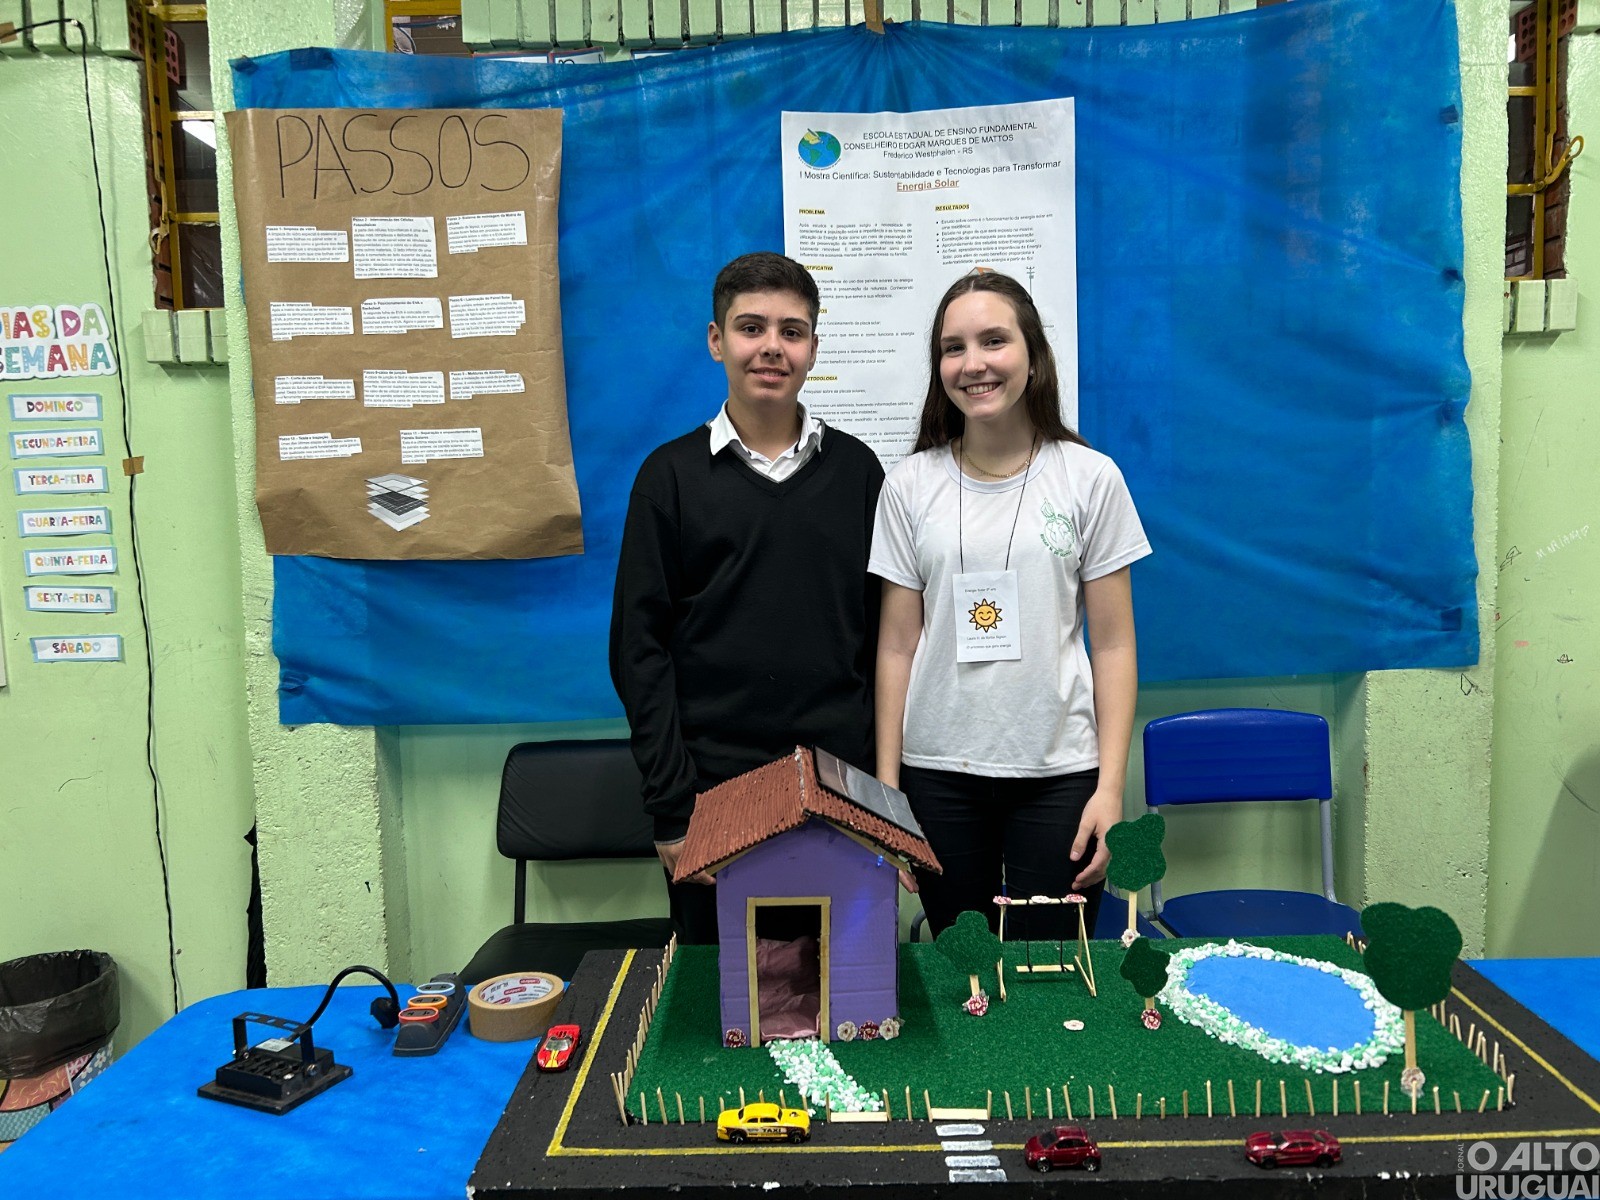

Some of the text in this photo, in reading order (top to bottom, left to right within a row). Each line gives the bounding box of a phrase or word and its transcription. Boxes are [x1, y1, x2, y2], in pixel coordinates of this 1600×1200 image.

[863, 122, 1037, 140] ESCOLA ESTADUAL DE ENSINO FUNDAMENTAL
[844, 134, 1014, 151] CONSELHEIRO EDGAR MARQUES DE MATTOS
[276, 113, 530, 199] PASSOS
[883, 150, 913, 159] Frederico
[915, 149, 956, 159] Westphalen
[804, 172, 830, 180] Mostra
[873, 170, 934, 179] Sustentabilidade
[944, 166, 990, 176] Tecnologias
[992, 165, 1011, 174] para
[1013, 159, 1061, 171] Transformar
[896, 179, 959, 192] Energia Solar
[0, 308, 103, 340] IAS DA
[27, 401, 83, 413] DOMINGO
[16, 436, 96, 449] SEGUNDA-FEIRA
[27, 515, 103, 527] QUARTA-FEIRA
[35, 555, 107, 567] QUINTA-FEIRA
[37, 593, 103, 603] SEXTA-FEIRA
[52, 640, 101, 654] SÁBADO
